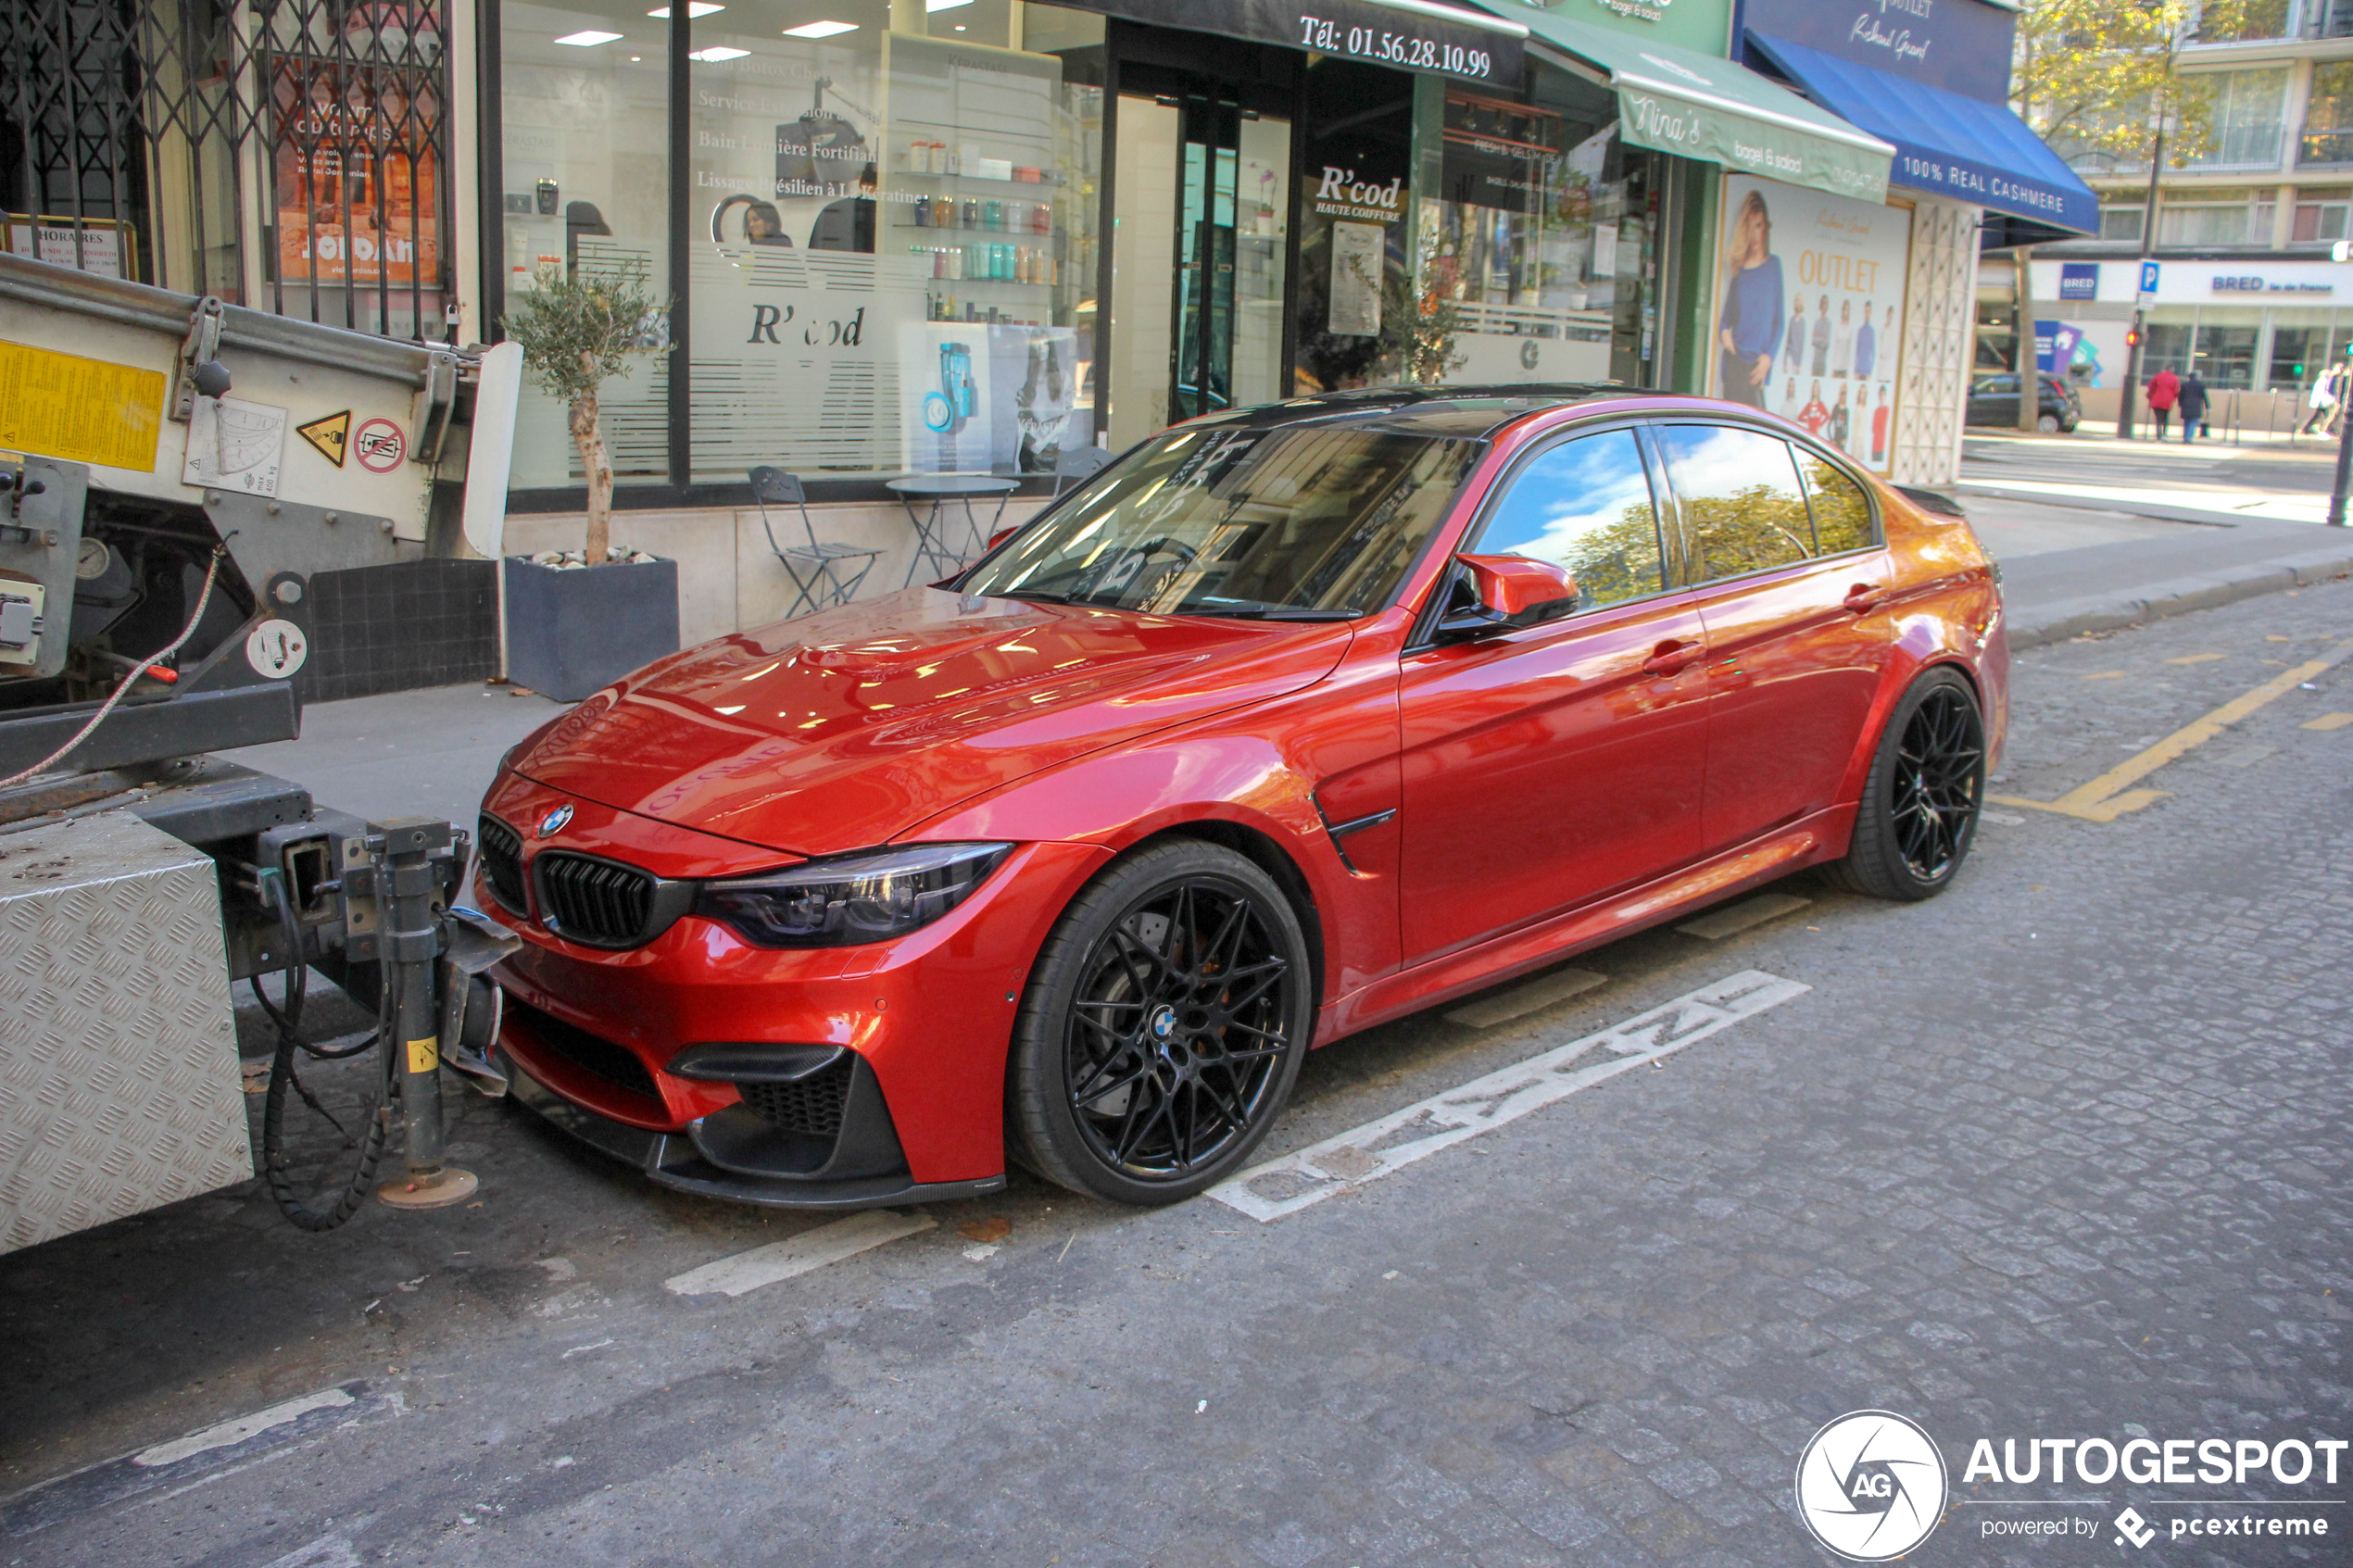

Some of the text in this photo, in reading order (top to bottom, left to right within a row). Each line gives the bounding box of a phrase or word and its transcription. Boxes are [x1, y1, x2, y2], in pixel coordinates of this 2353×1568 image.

[1301, 15, 1491, 78] Tél: 01.56.28.10.99
[699, 131, 736, 149] Bain
[1631, 94, 1700, 144] Nina's
[1735, 140, 1764, 167] bagel
[1776, 156, 1802, 173] salad
[698, 170, 755, 192] Lissage
[760, 174, 824, 197] Brésilien
[1315, 166, 1402, 209] R'cod
[1904, 156, 2064, 213] 100% REAL CASHMERE
[1315, 202, 1402, 223] HAUTE COIFFURE
[39, 231, 104, 244] HORARES
[1799, 249, 1881, 294] OUTLET
[2063, 278, 2095, 289] BRED
[2145, 266, 2157, 288] P
[2212, 276, 2264, 291] BRED
